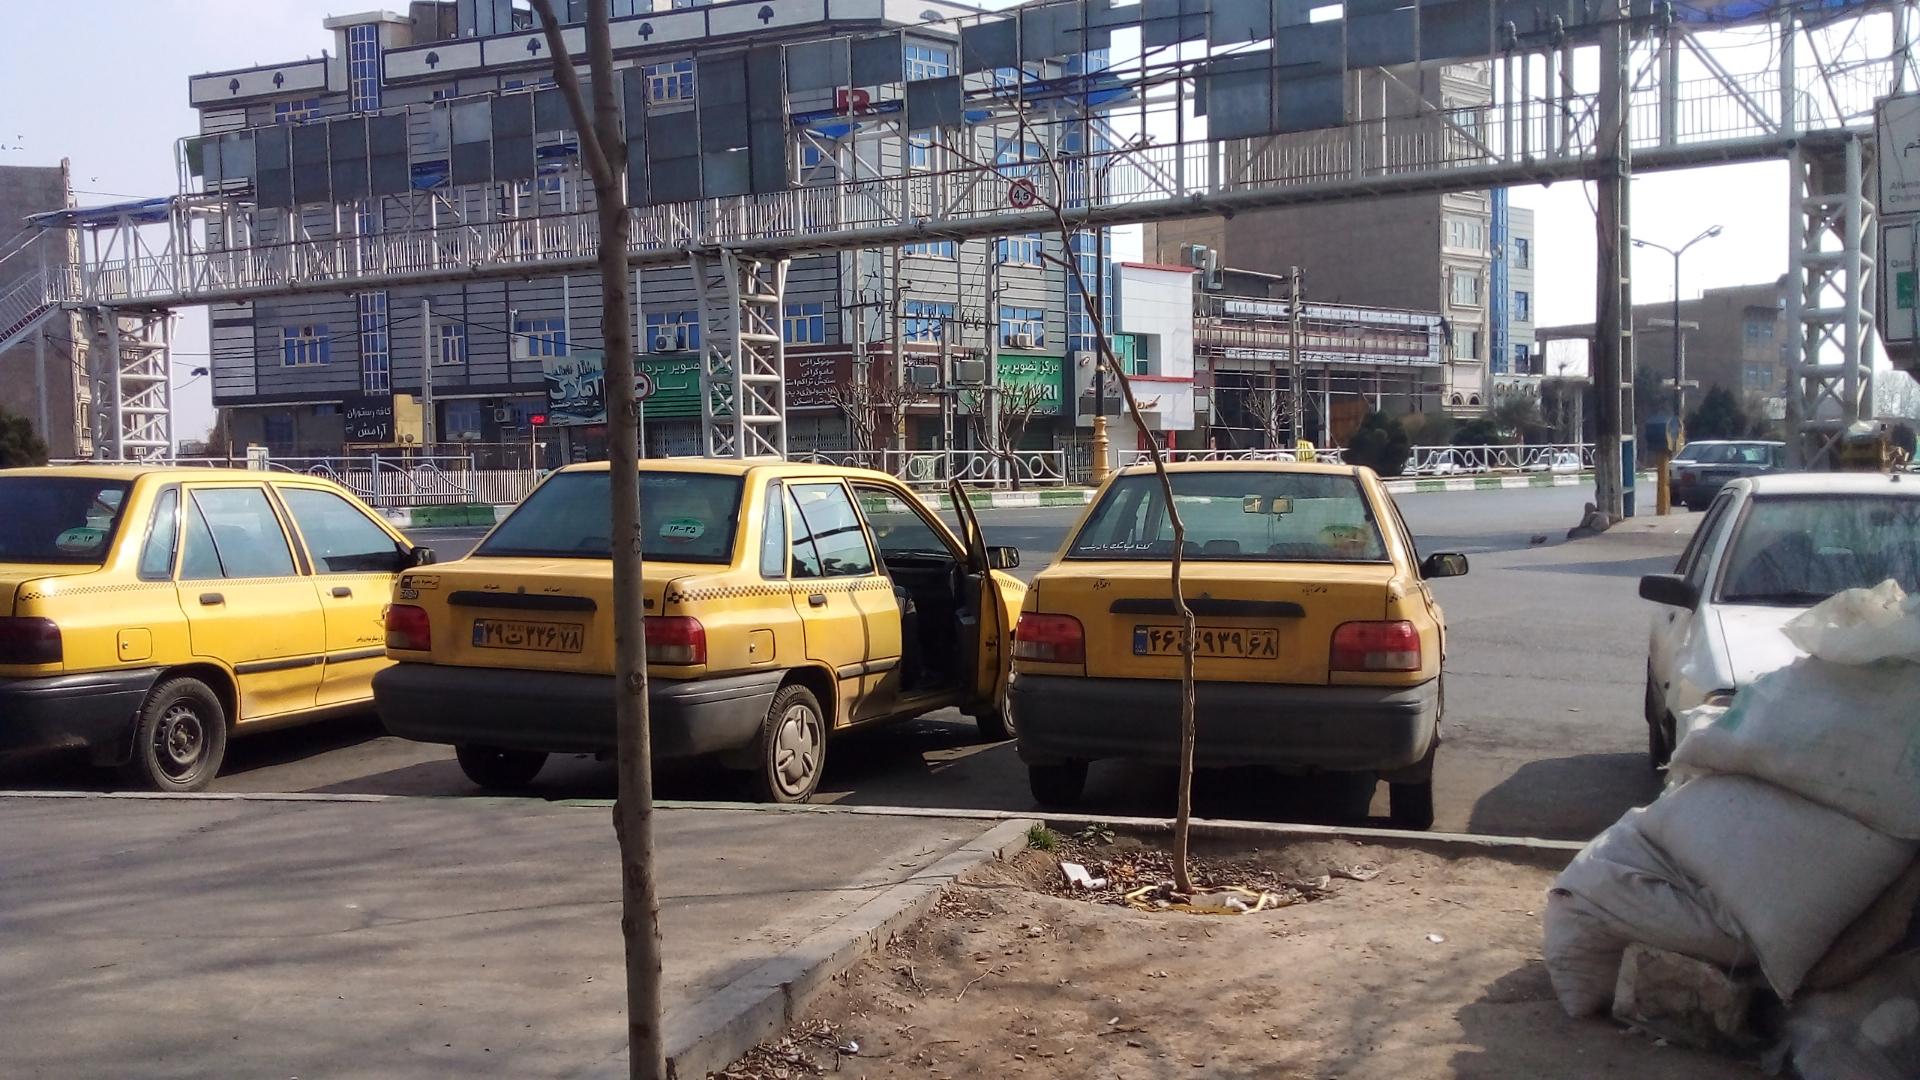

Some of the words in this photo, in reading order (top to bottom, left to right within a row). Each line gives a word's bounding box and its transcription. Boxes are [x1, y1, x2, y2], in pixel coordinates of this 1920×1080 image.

[1013, 189, 1030, 202] 4.5
[1010, 360, 1037, 375] تصویر
[1039, 360, 1059, 375] مرکز
[357, 422, 388, 440] آرامش
